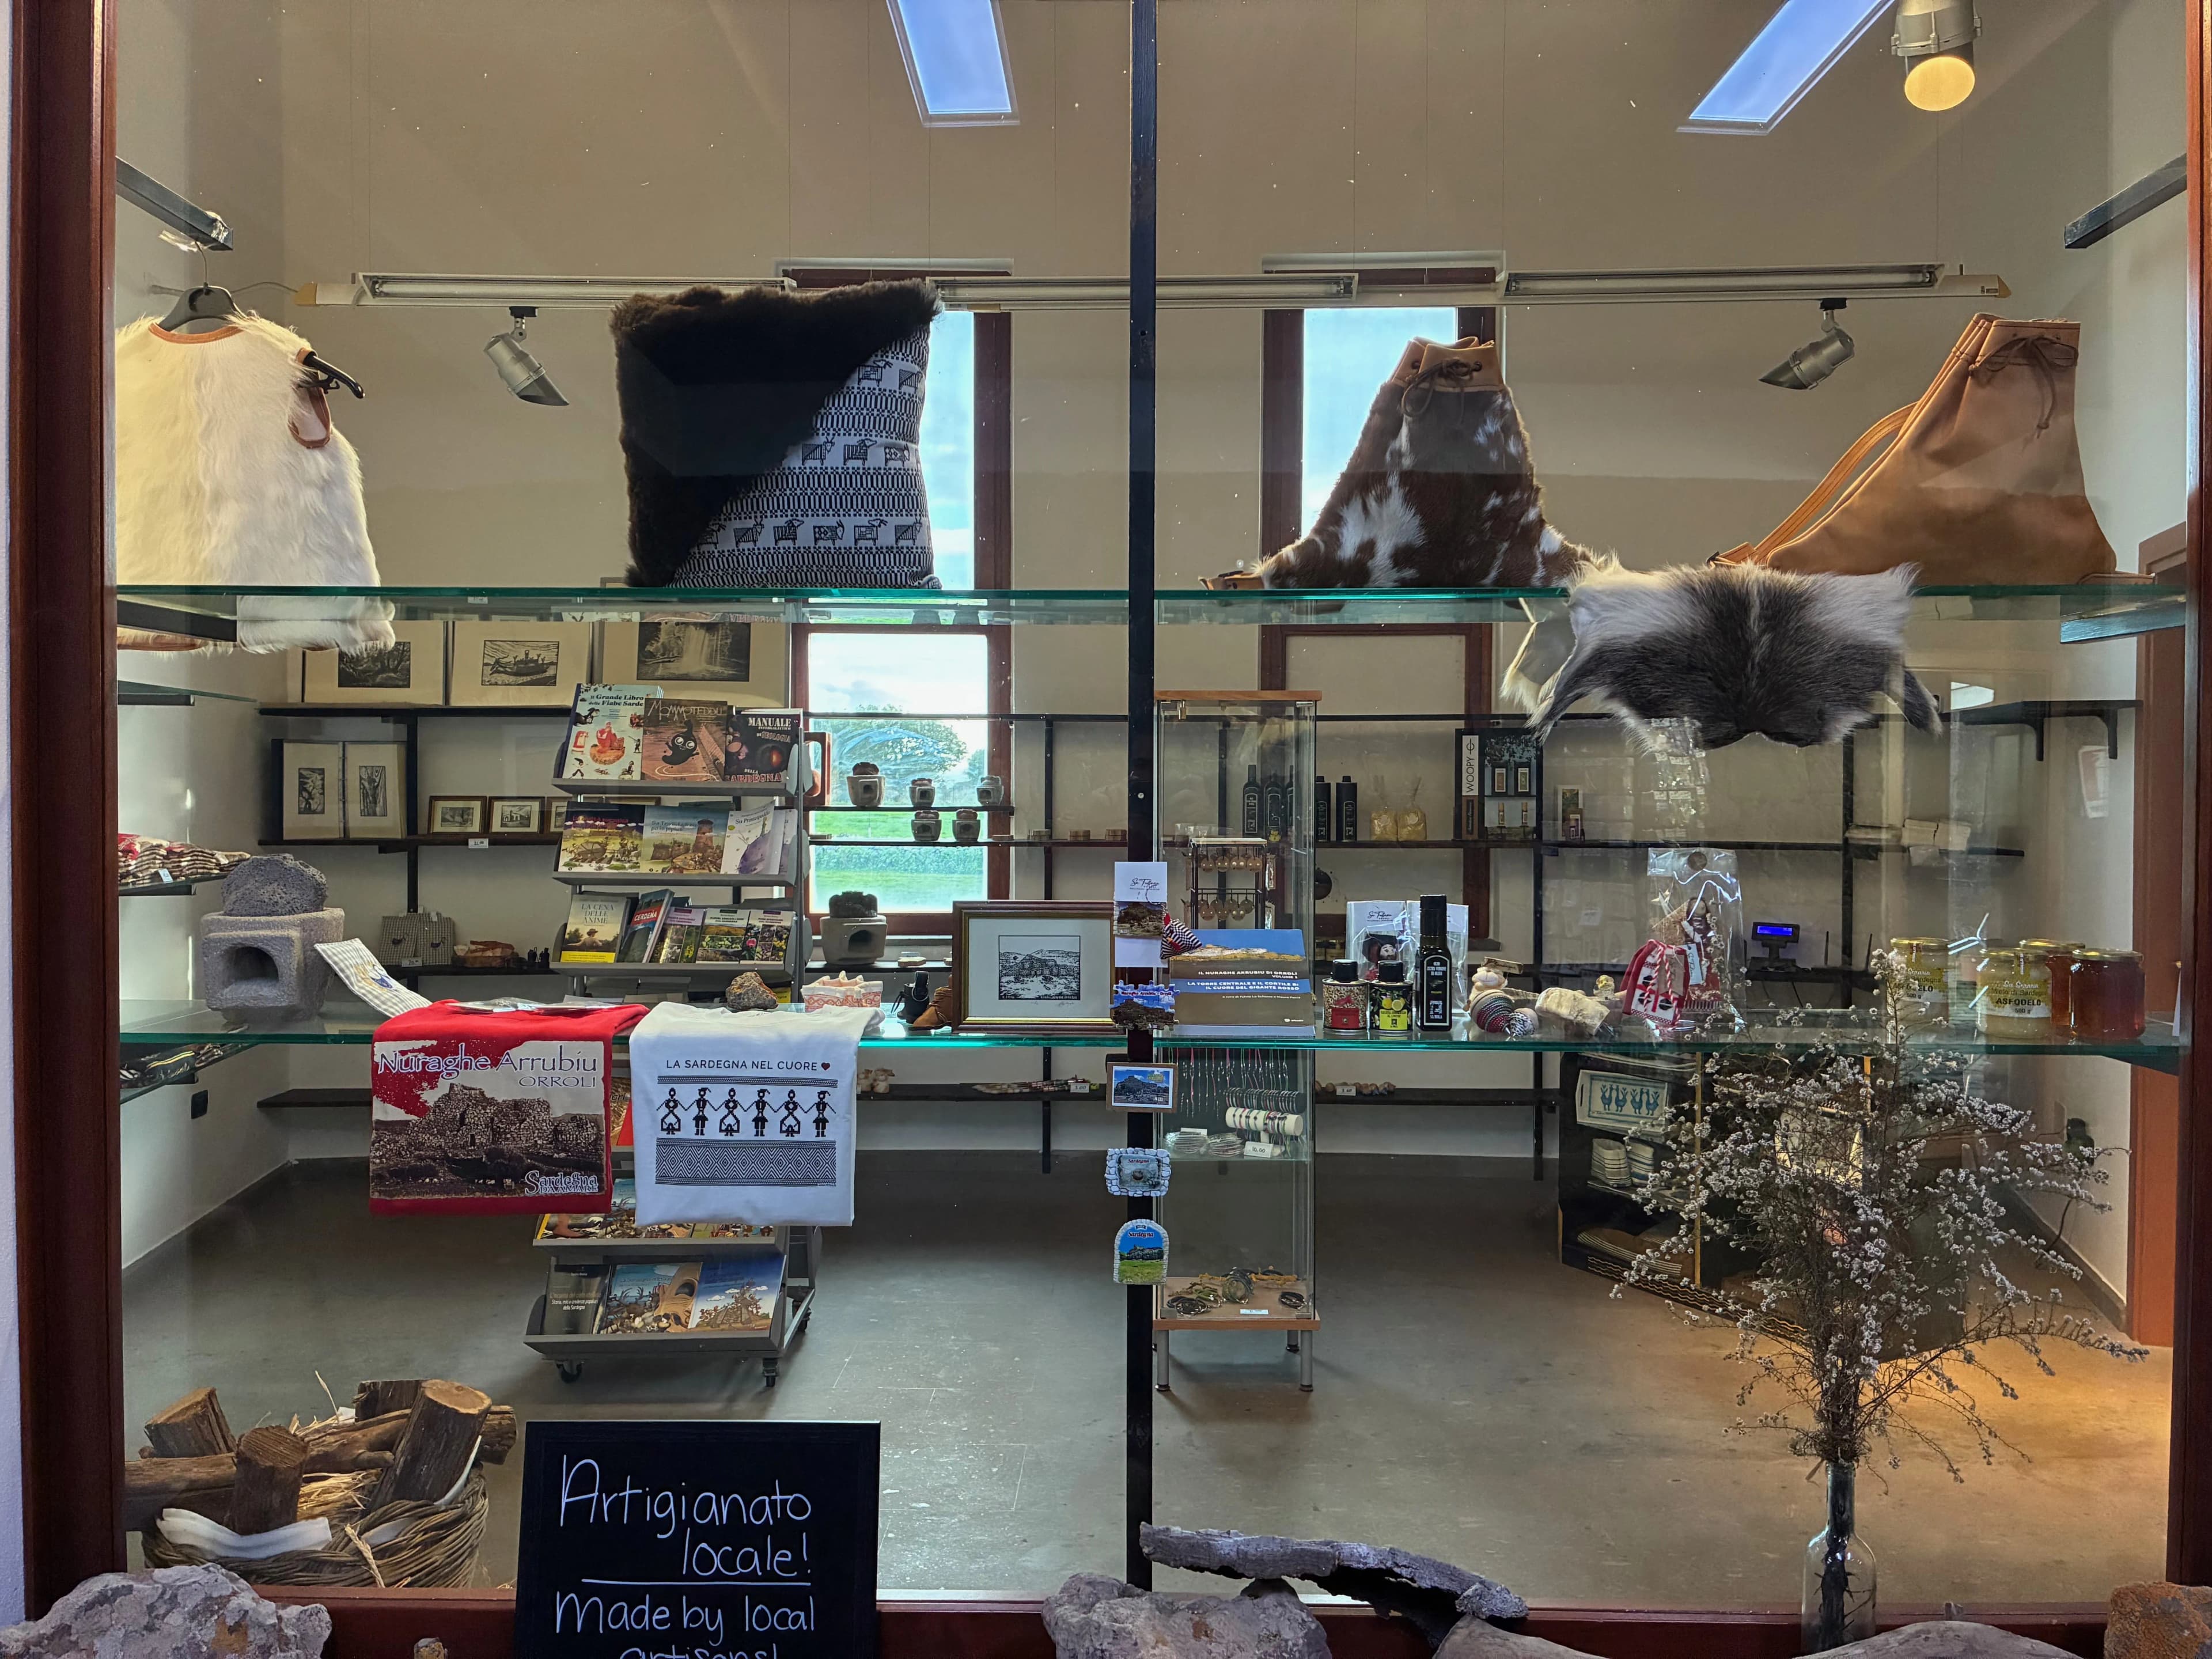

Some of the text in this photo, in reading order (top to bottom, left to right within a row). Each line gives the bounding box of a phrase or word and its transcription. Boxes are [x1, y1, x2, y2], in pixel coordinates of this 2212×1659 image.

[748, 717, 791, 727] MANUALE
[725, 773, 783, 783] SARDEGNA
[1466, 756, 1475, 793] WOOPY
[1995, 998, 2041, 1006] ASFODELO
[378, 1043, 597, 1080] Nuraghe Arrubiu
[666, 1059, 817, 1071] LA SARDEGNA NEL CUORE
[519, 1076, 596, 1088] ORROLI
[525, 1170, 599, 1195] Sardegna
[556, 1184, 599, 1194] AMARE
[559, 1454, 812, 1539] Artigianato
[683, 1527, 812, 1577] locale!
[555, 1590, 815, 1646] Made by local
